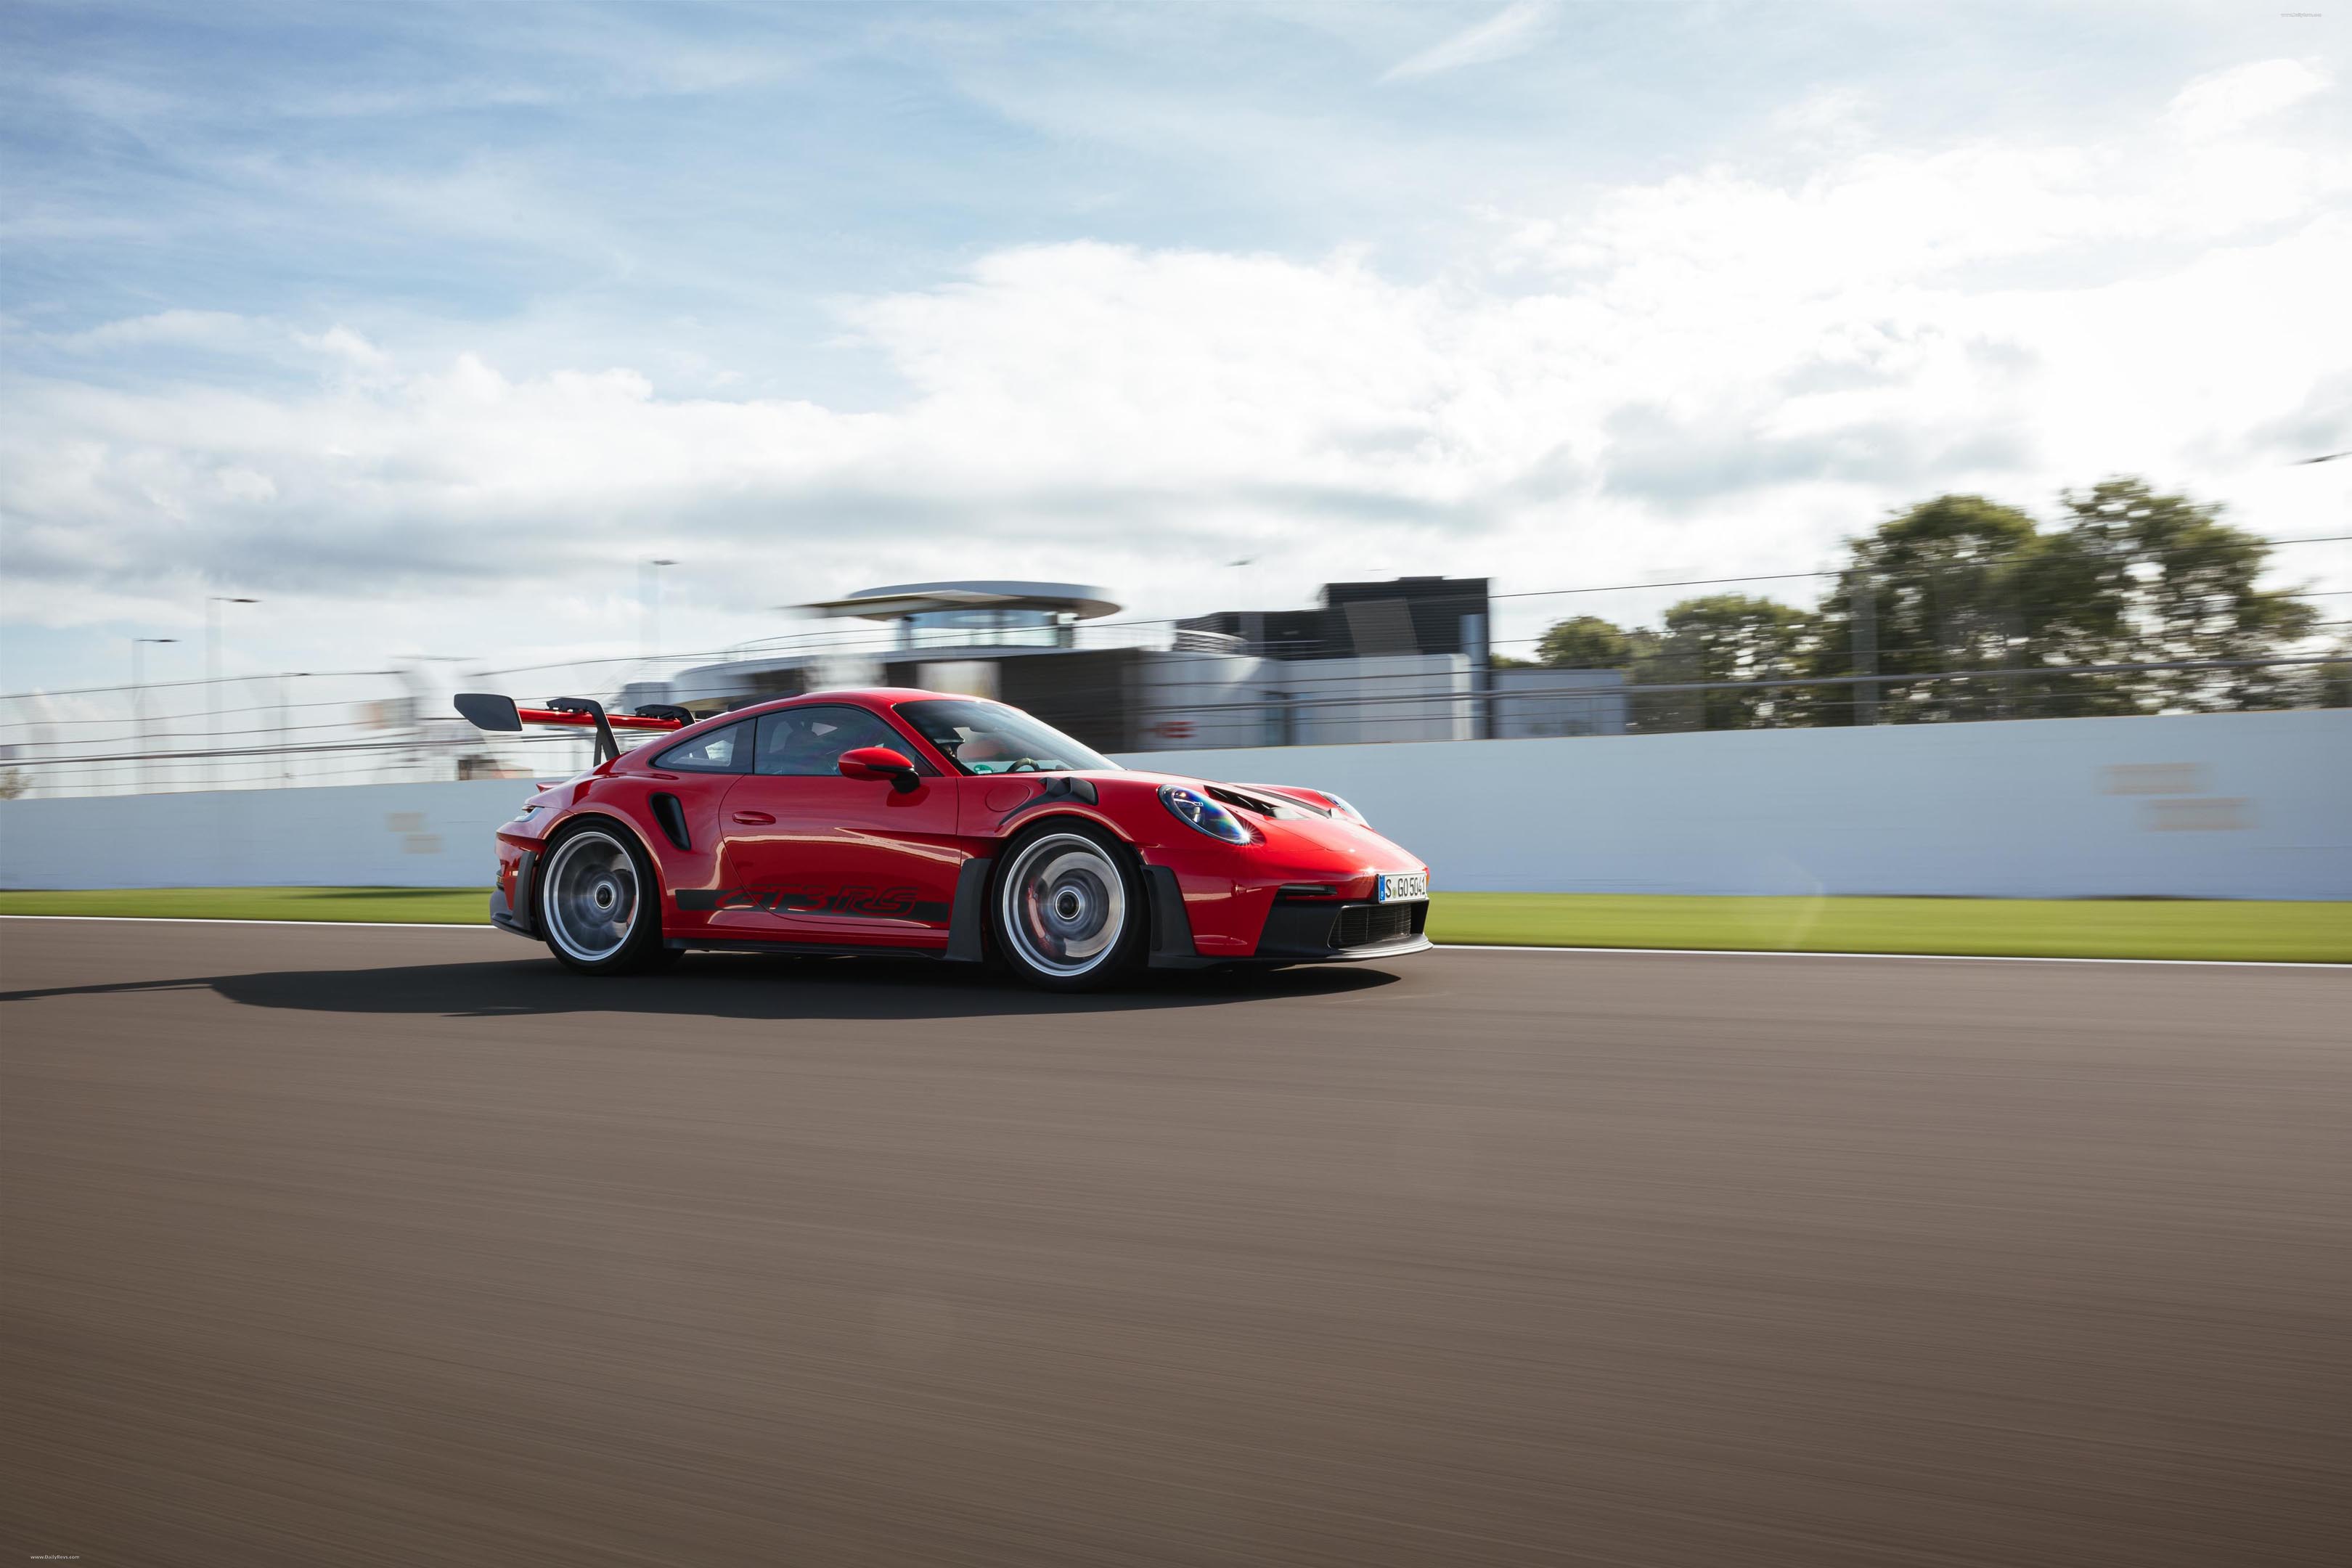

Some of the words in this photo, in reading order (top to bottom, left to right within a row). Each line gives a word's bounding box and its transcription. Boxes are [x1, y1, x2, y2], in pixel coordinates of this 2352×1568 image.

[714, 883, 828, 912] GT3
[830, 885, 918, 917] RS
[1386, 879, 1392, 898] S
